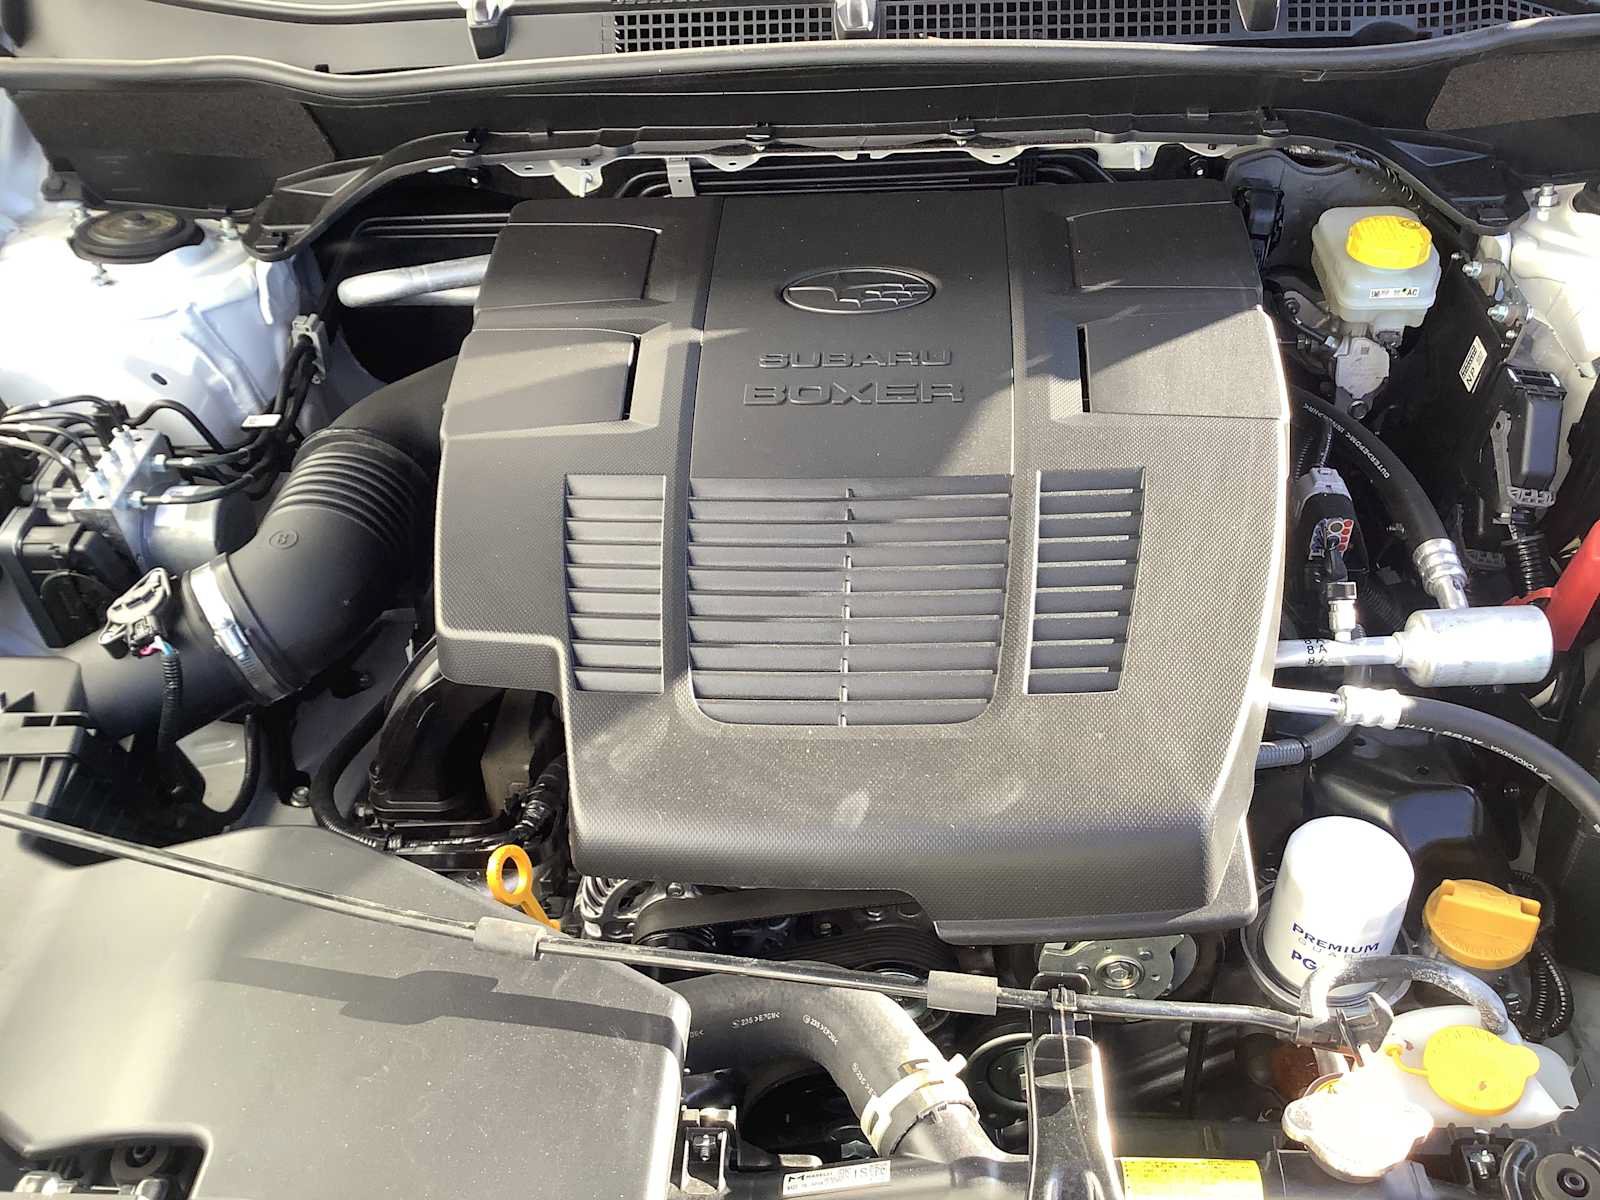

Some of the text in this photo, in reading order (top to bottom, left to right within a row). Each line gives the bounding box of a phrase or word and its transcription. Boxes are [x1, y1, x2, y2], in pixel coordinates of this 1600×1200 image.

[759, 350, 952, 368] SUBARU
[743, 381, 964, 405] BOXER
[1292, 922, 1380, 954] PREMIUM
